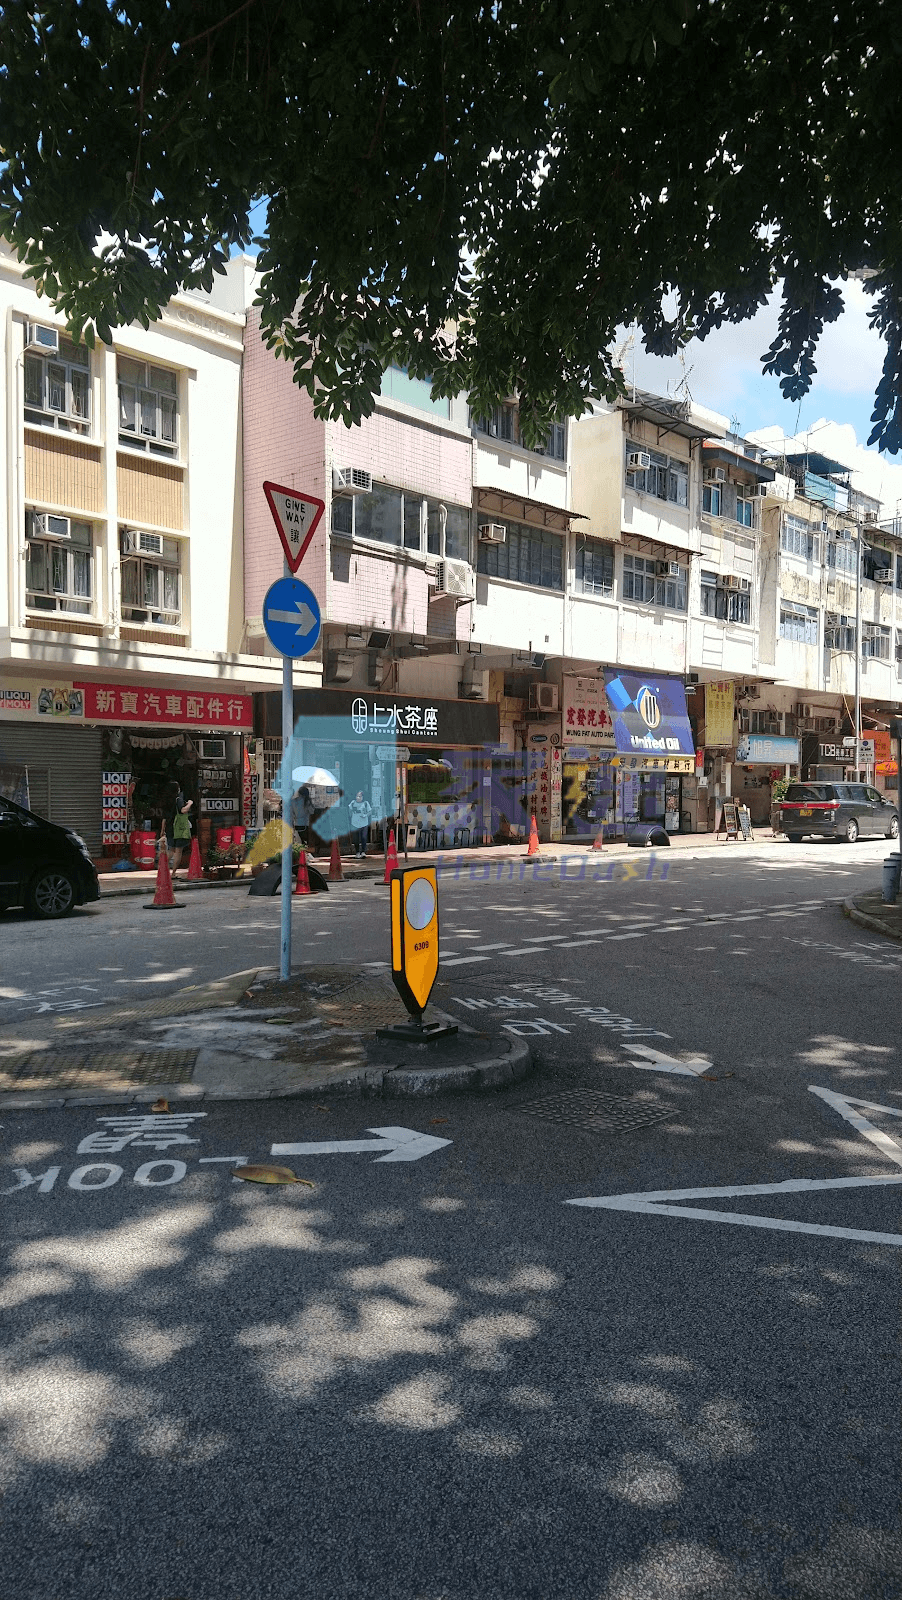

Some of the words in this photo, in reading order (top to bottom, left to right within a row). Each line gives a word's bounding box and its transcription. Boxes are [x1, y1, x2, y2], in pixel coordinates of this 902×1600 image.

[285, 498, 306, 514] GIVE
[285, 510, 305, 525] WAY
[290, 528, 300, 544] 讓
[5, 690, 30, 700] LIQUI
[6, 700, 30, 709] MOLY
[96, 688, 244, 721] 新寶汽車配件行
[368, 702, 438, 731] 上水茶座
[631, 735, 666, 750] United
[666, 738, 681, 752] Oil
[102, 773, 131, 784] LIQU
[207, 800, 233, 810] LIQUI
[102, 808, 127, 819] MOL
[509, 983, 590, 1004] LOOK
[564, 1006, 674, 1039] RIGHT
[76, 1112, 208, 1154] 望
[0, 1156, 249, 1196] LOOK
